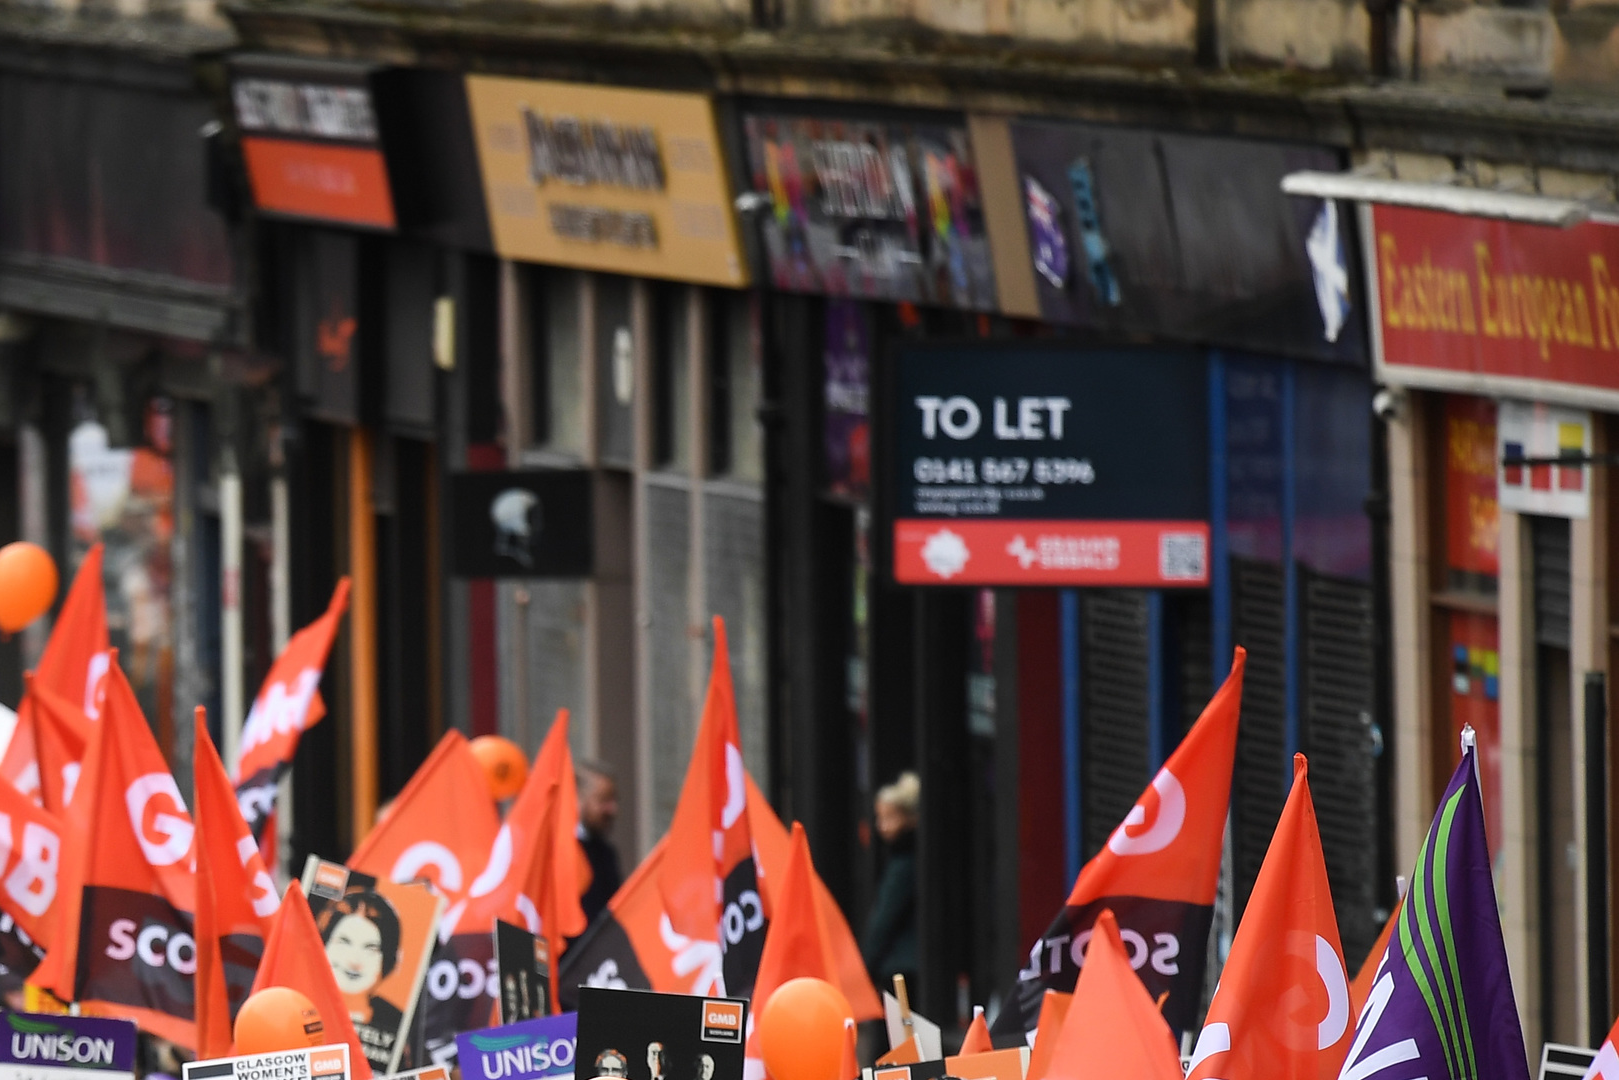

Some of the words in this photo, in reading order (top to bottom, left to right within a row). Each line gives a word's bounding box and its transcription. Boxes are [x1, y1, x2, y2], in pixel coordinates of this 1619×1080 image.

[1382, 232, 1477, 335] Eastern
[1475, 240, 1594, 362] European
[914, 396, 981, 440] TO
[993, 396, 1072, 440] LET
[708, 1012, 736, 1026] GMB
[11, 1033, 115, 1065] UNISON
[236, 1053, 307, 1071] GLASGOW
[313, 1058, 343, 1072] GMB
[482, 1037, 577, 1080] UNISO
